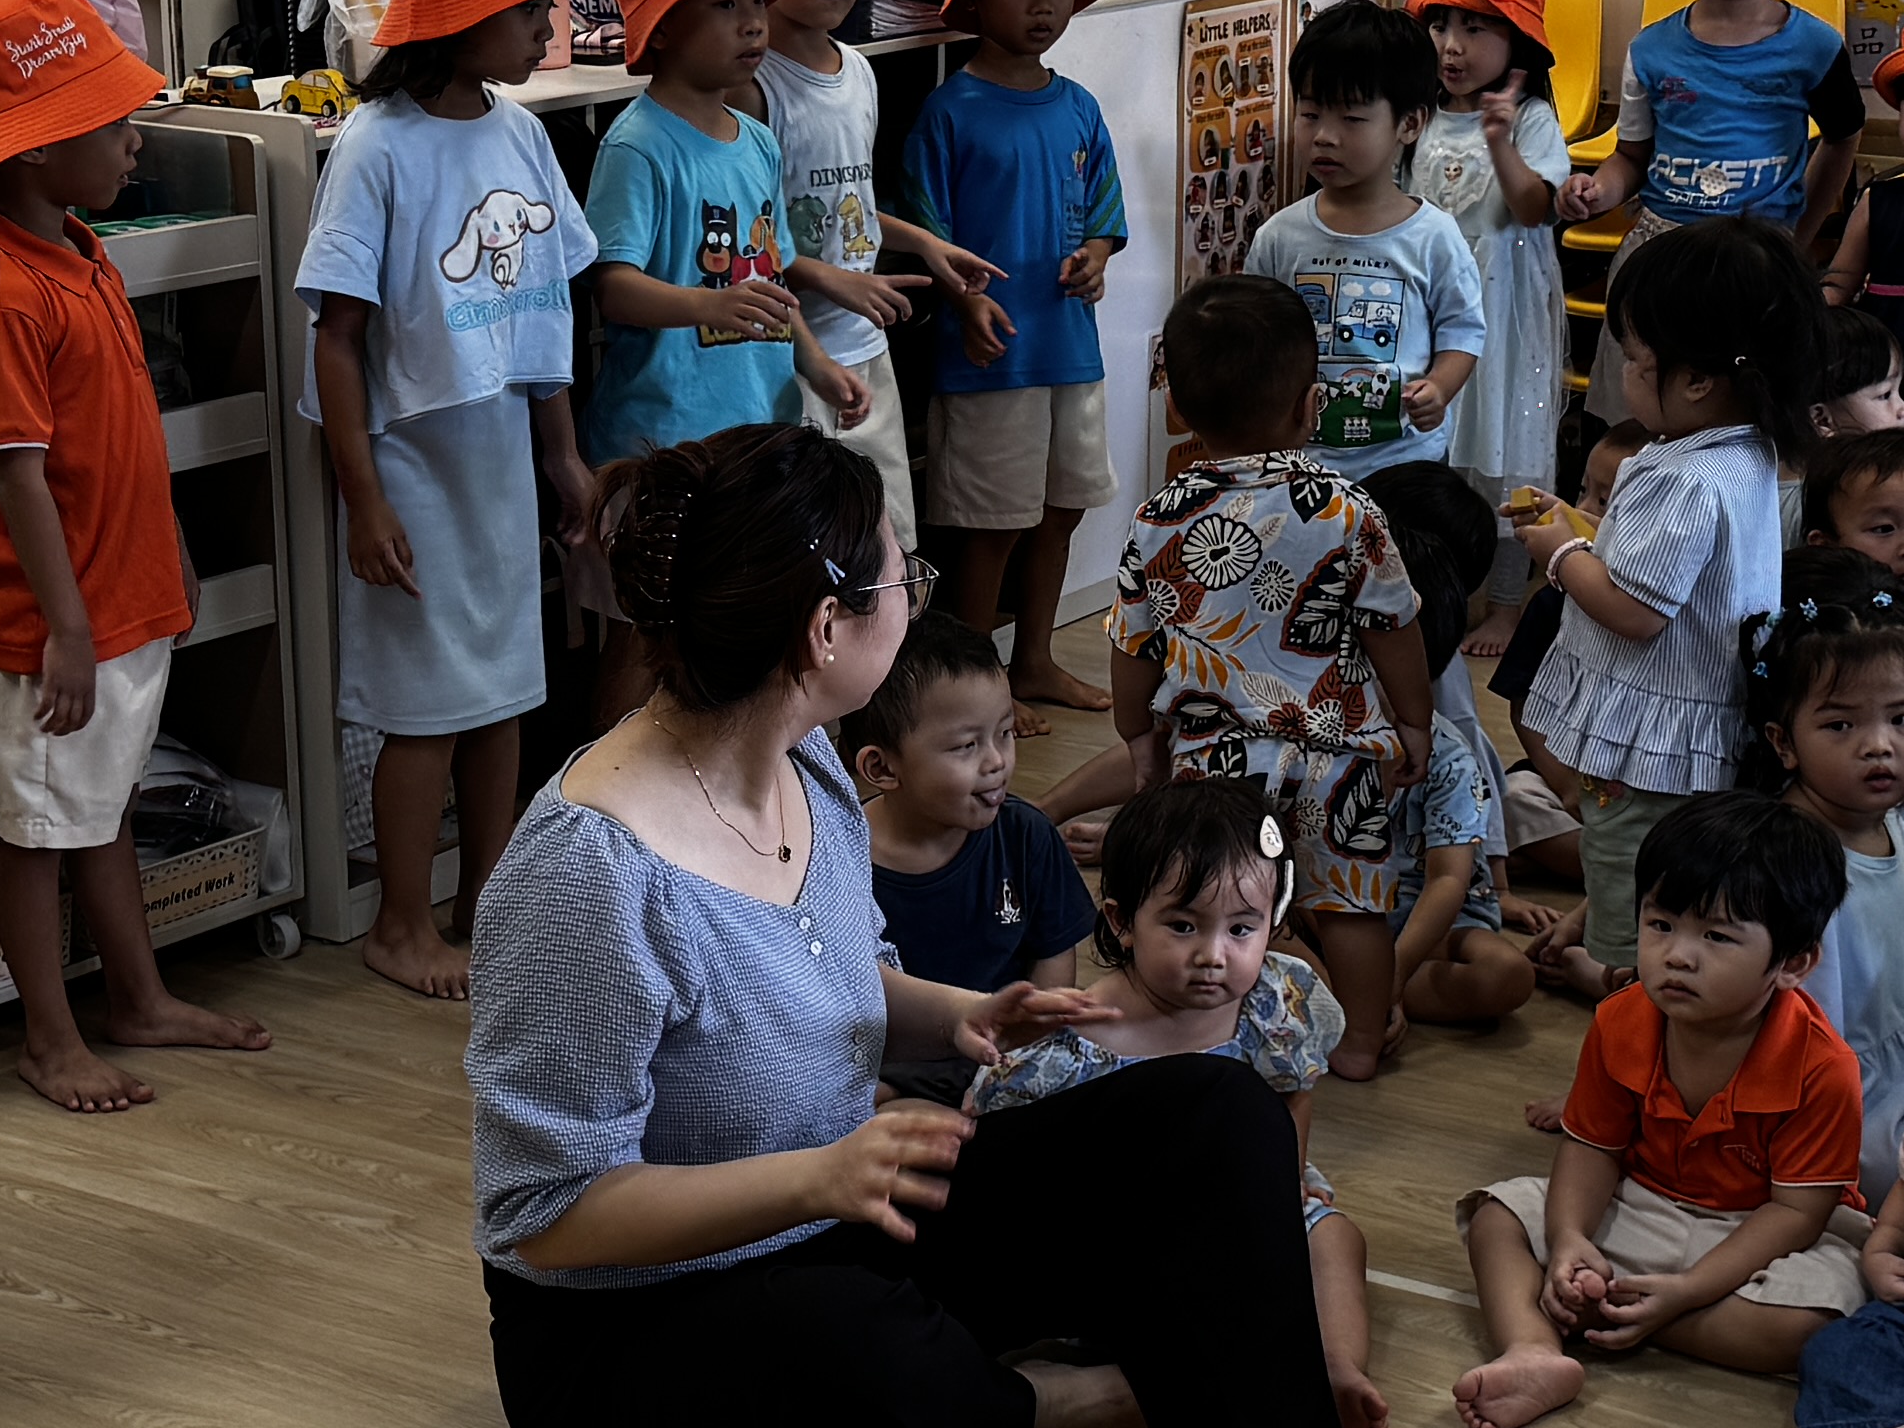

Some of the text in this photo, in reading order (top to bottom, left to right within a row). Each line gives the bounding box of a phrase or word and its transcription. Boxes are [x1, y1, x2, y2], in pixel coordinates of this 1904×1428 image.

[1199, 12, 1271, 44] LITTLE HELPERS
[144, 871, 235, 914] ompleted Work
